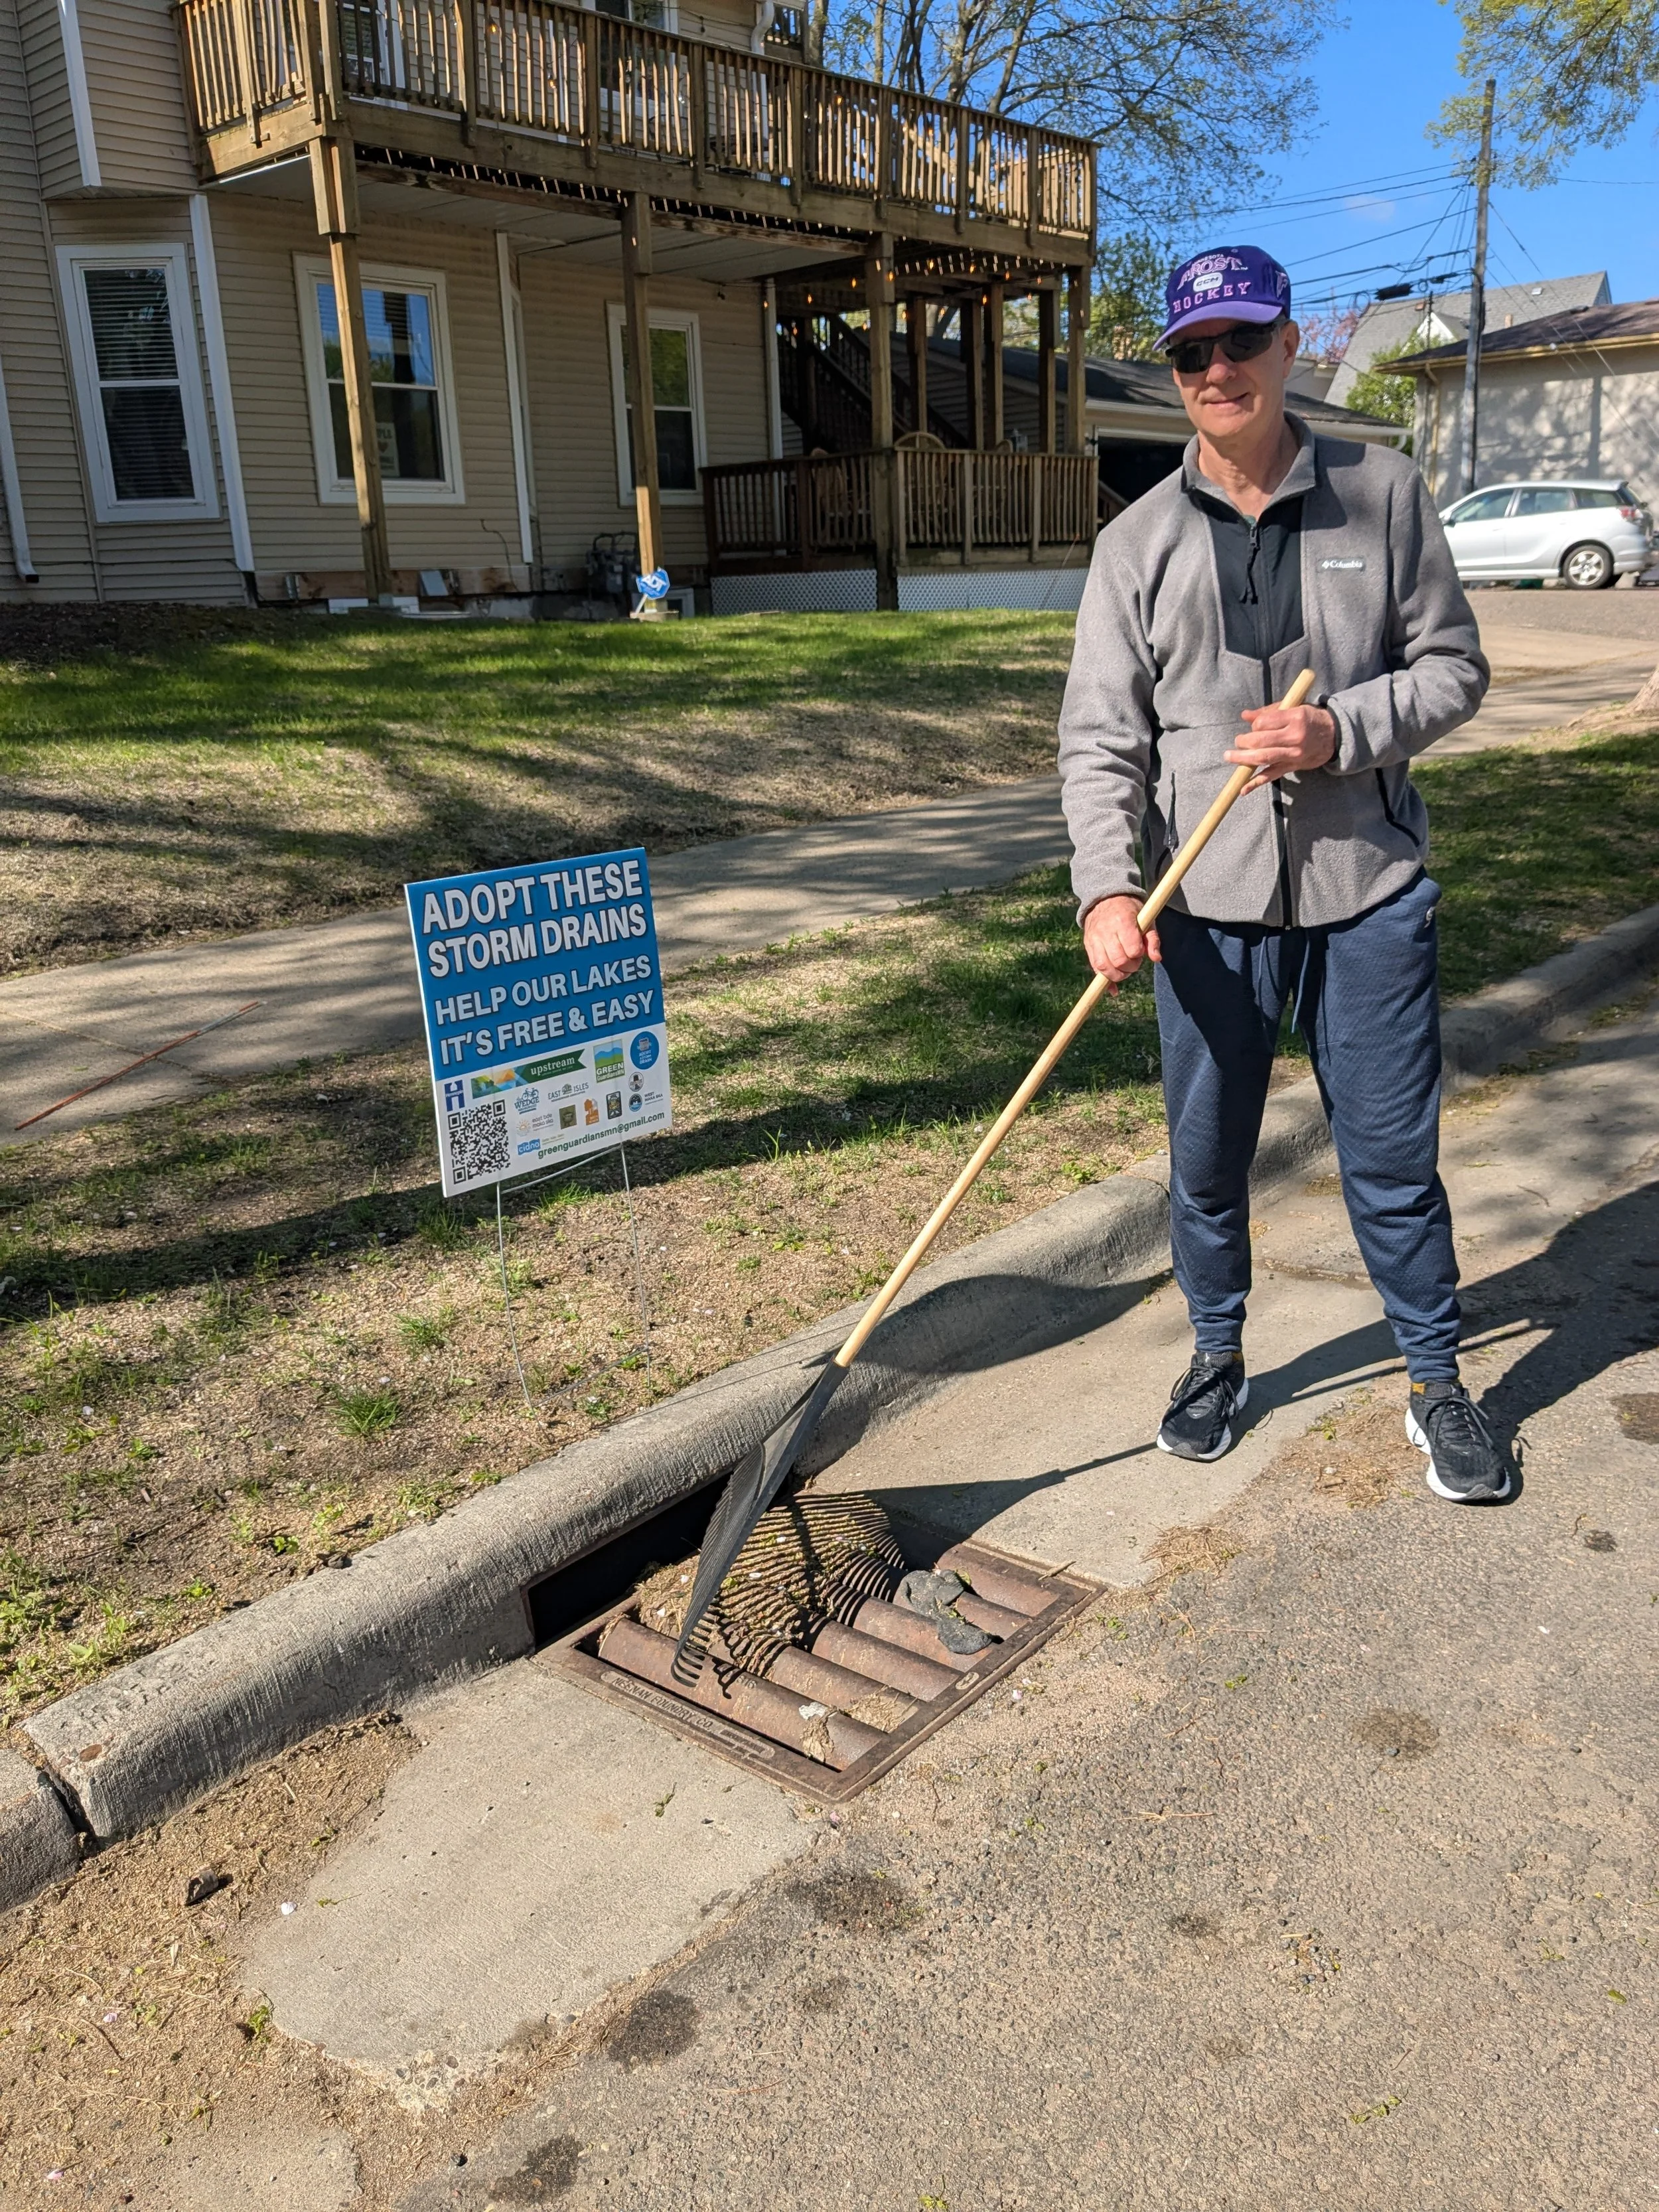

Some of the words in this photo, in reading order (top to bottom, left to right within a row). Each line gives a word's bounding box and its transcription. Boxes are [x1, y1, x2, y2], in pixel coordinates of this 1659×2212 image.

[1177, 256, 1243, 291] FROST
[1196, 276, 1219, 287] CCM
[1173, 281, 1252, 313] HOCKEY
[1329, 559, 1363, 569] Columbia
[641, 574, 667, 592] ADT
[423, 876, 536, 934] ADOPT
[539, 859, 643, 911] THESE
[428, 923, 538, 978] STORM
[540, 903, 646, 954] DRAINS
[435, 986, 507, 1025] HELP
[512, 973, 568, 1006] OUR
[571, 955, 651, 994] LAKES
[440, 1029, 494, 1065] IT'S
[497, 1011, 565, 1051] FREE
[568, 1007, 588, 1032] &
[591, 990, 654, 1027] EASY
[530, 1057, 575, 1076] upstream
[596, 1062, 624, 1075] GREEN
[514, 1096, 540, 1110] WEDGE
[547, 1090, 561, 1100] EAST
[573, 1082, 589, 1092] ISLES
[538, 1112, 665, 1160] greenguardiansmn@gmail.com
[650, 1695, 697, 1722] FOUNDRY
